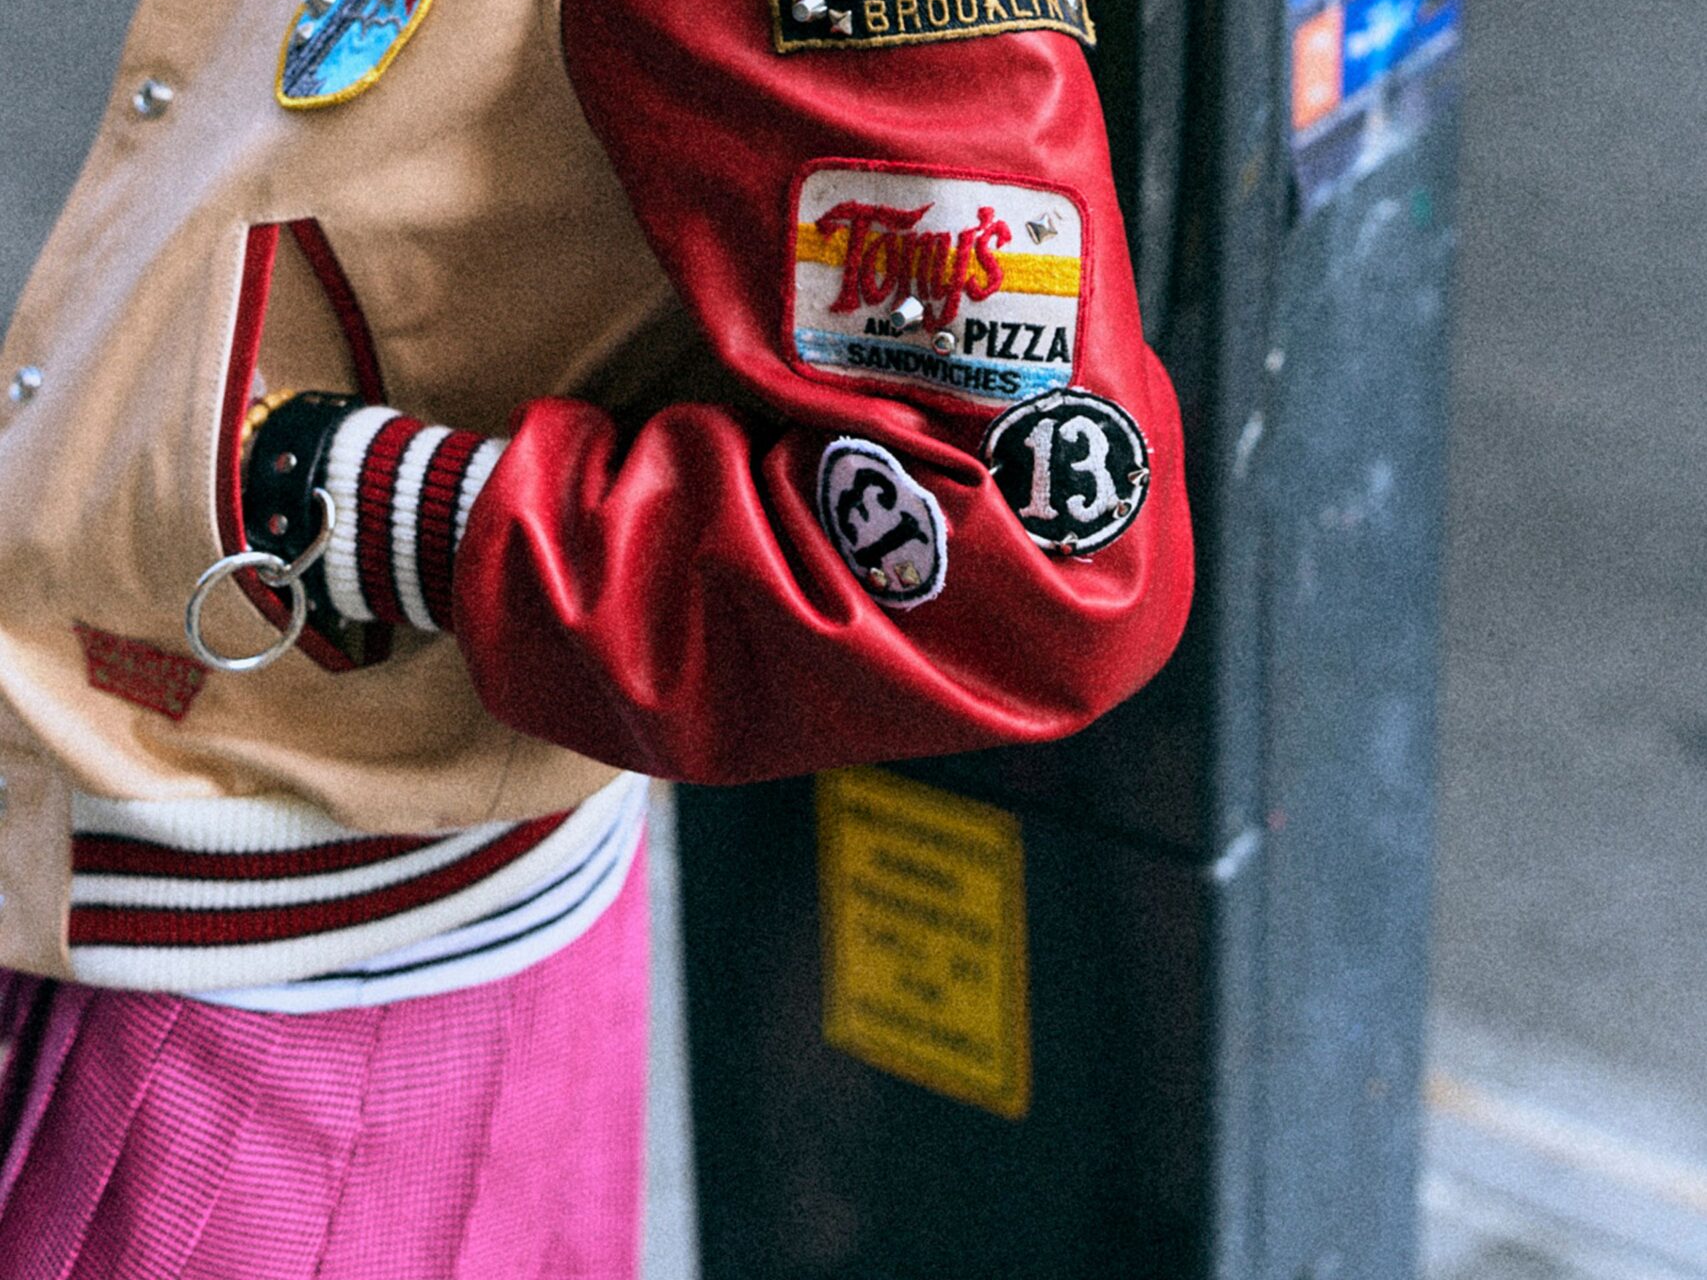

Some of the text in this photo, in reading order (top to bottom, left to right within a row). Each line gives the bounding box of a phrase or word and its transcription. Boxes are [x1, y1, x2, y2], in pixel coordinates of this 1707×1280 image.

[814, 200, 1013, 333] Tony's
[849, 343, 1022, 395] SANDWICHES
[963, 317, 1072, 364] PIZZA
[1018, 415, 1124, 523] 13
